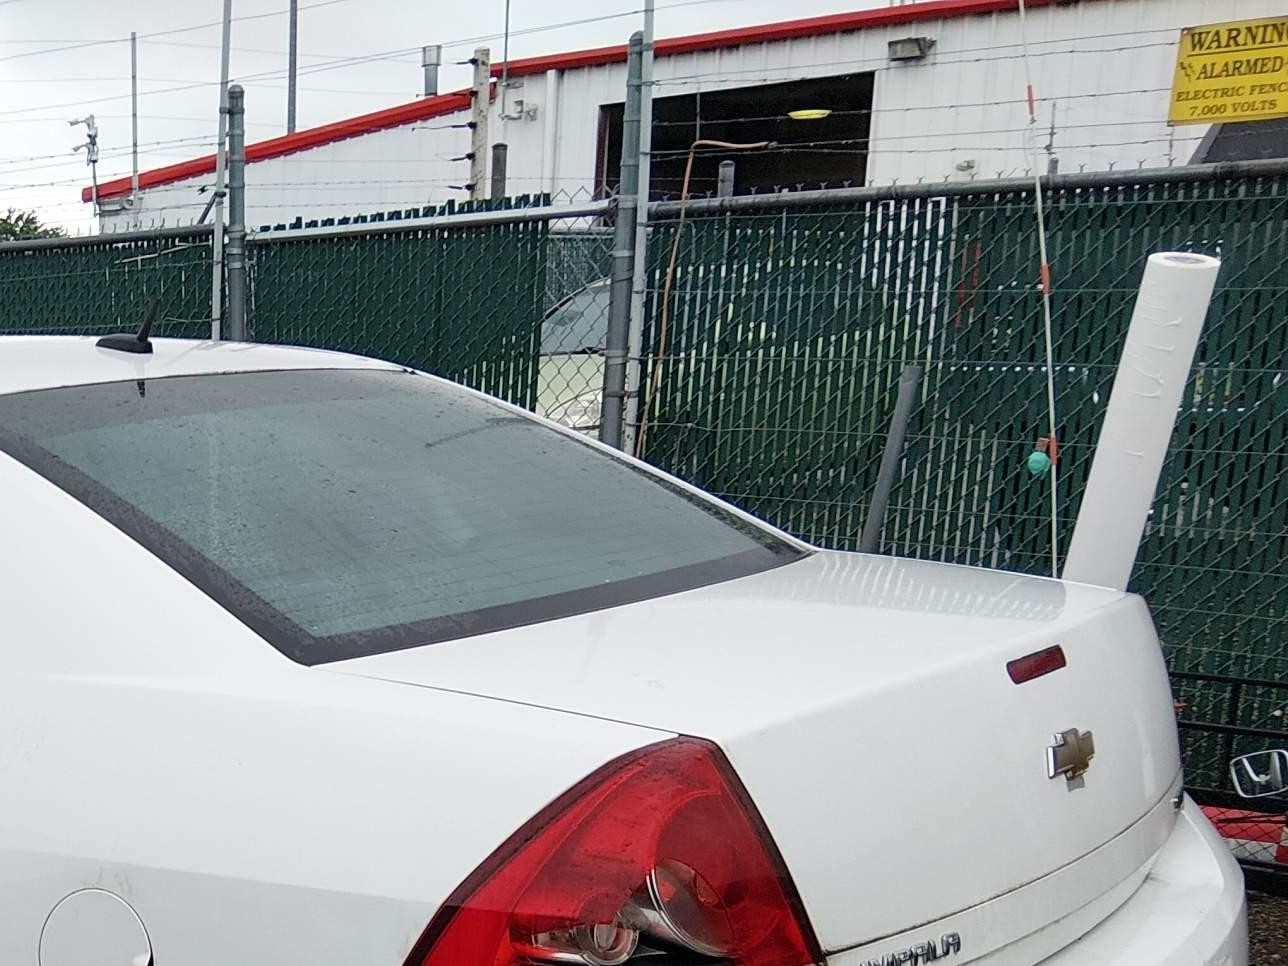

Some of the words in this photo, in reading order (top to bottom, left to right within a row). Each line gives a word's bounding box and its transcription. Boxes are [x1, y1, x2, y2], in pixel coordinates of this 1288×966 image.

[1190, 21, 1288, 52] WARNIN
[1196, 55, 1284, 80] ALARMED
[1176, 86, 1246, 102] ELECTRIC
[1249, 81, 1288, 95] FENC
[1230, 99, 1278, 113] VOLTS
